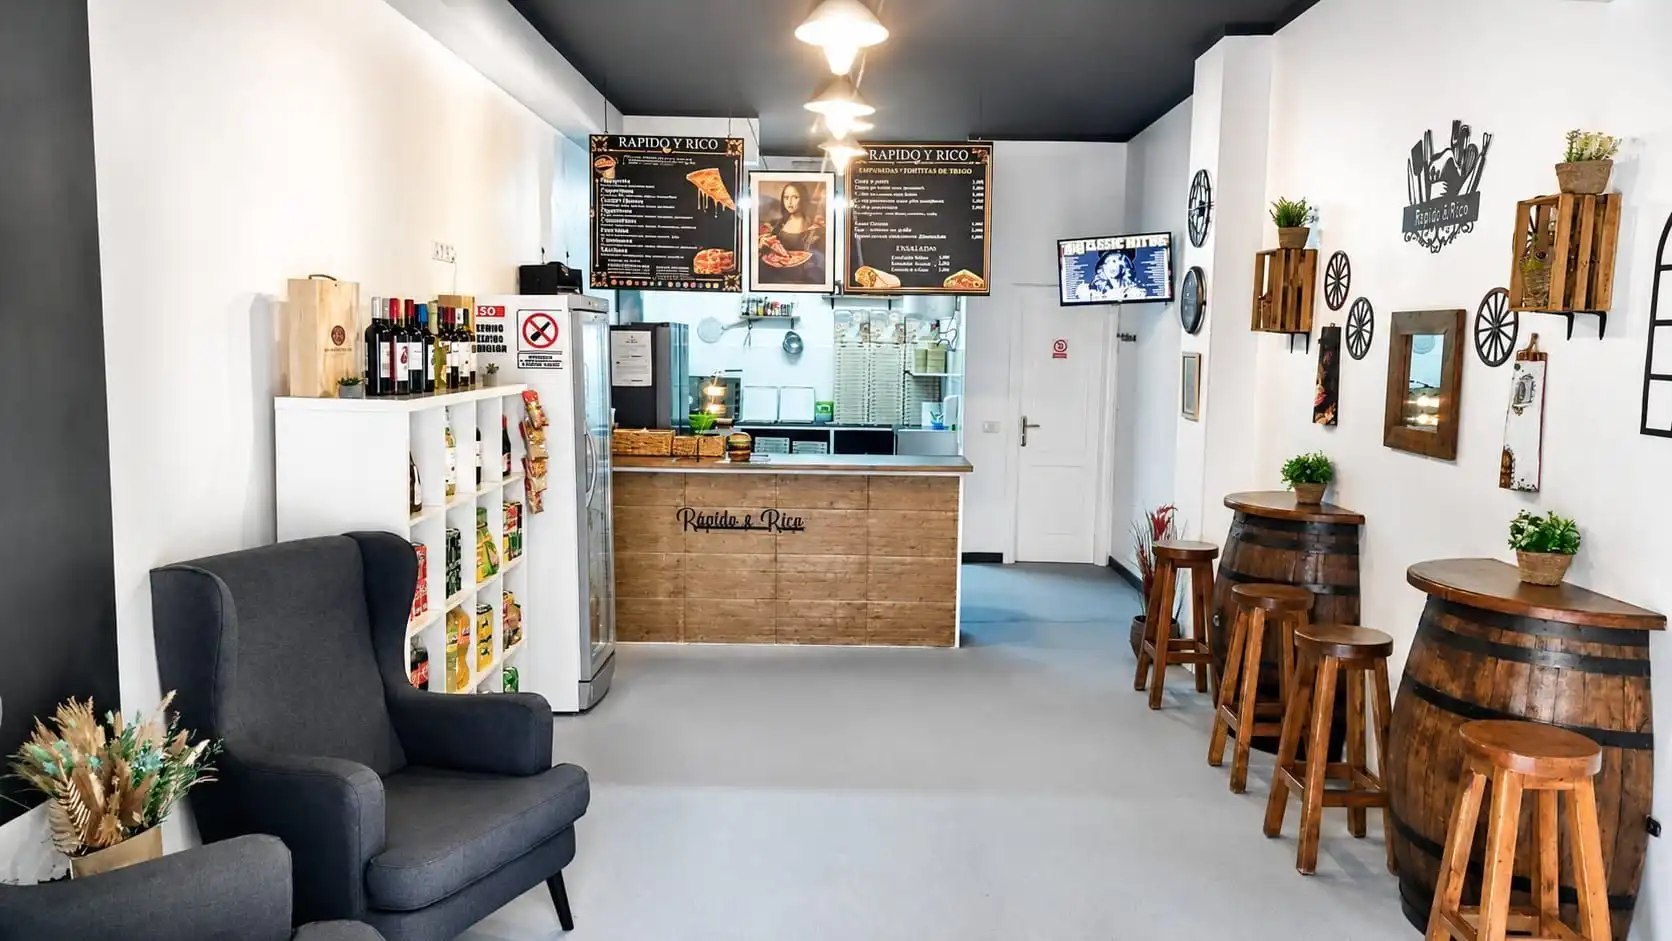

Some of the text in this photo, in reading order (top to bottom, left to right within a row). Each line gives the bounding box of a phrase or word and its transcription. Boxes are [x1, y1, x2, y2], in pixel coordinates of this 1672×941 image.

[618, 136, 719, 150] RAPIDO Y RICO
[869, 149, 969, 161] RAPIDO Y RICO
[1449, 201, 1469, 219] Rico
